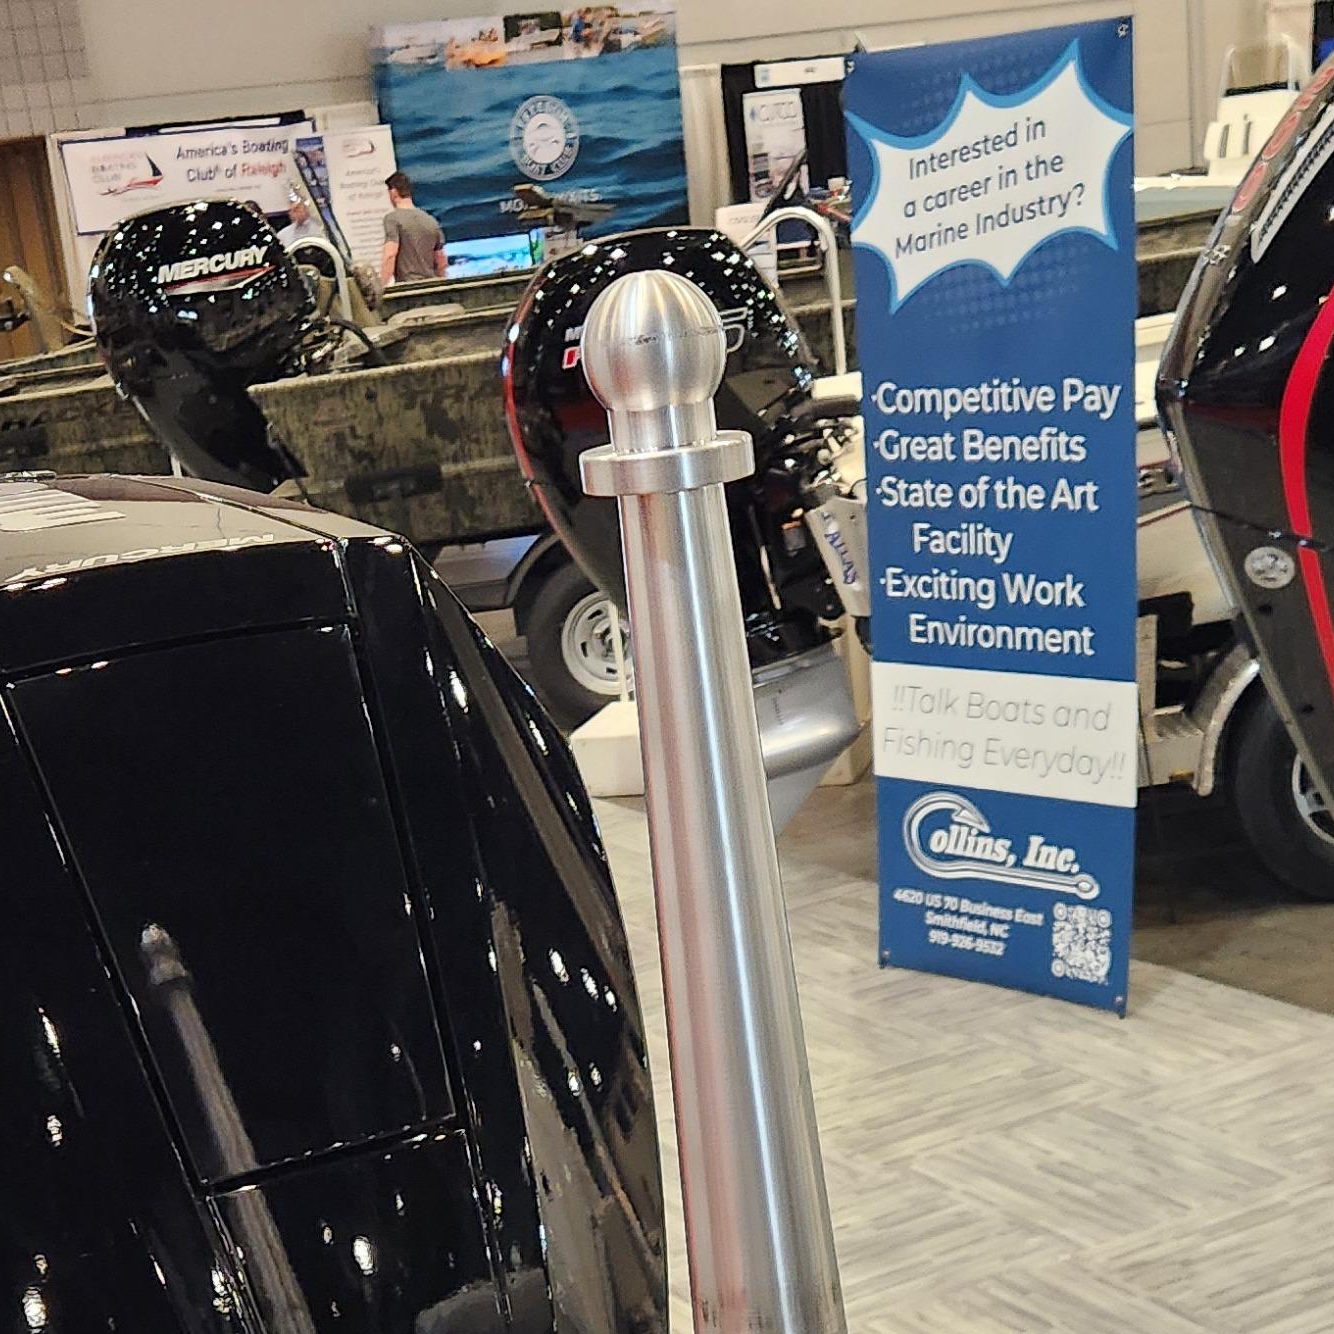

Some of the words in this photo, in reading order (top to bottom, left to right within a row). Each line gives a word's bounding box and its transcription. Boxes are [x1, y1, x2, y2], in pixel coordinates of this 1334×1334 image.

[908, 121, 1019, 181] Interested
[1026, 116, 1047, 142] in
[903, 199, 917, 219] a
[922, 177, 992, 214] career
[998, 166, 1019, 194] in
[1025, 152, 1065, 187] the
[894, 219, 969, 260] Marine
[975, 182, 1087, 236] Industry?
[156, 244, 270, 285] MERCURY
[875, 377, 1056, 421] Competitive
[1062, 377, 1122, 421] Pay
[878, 428, 957, 463] Great
[963, 426, 1088, 464] Benefits
[880, 476, 953, 510] State
[958, 476, 992, 511] of
[993, 478, 1048, 511] the
[1051, 479, 1100, 514] Art
[911, 521, 1014, 565] Facility
[885, 567, 998, 609] Exciting
[1001, 571, 1086, 609] Work
[908, 613, 1096, 657] Environment
[965, 691, 1047, 727] Boats
[1052, 701, 1114, 733] and
[881, 726, 975, 770] Fishing
[982, 737, 1128, 784] Everyday!!
[1022, 833, 1082, 875] Inc.
[959, 897, 1014, 922] Business
[1014, 906, 1046, 928] East
[989, 921, 1011, 939] NC
